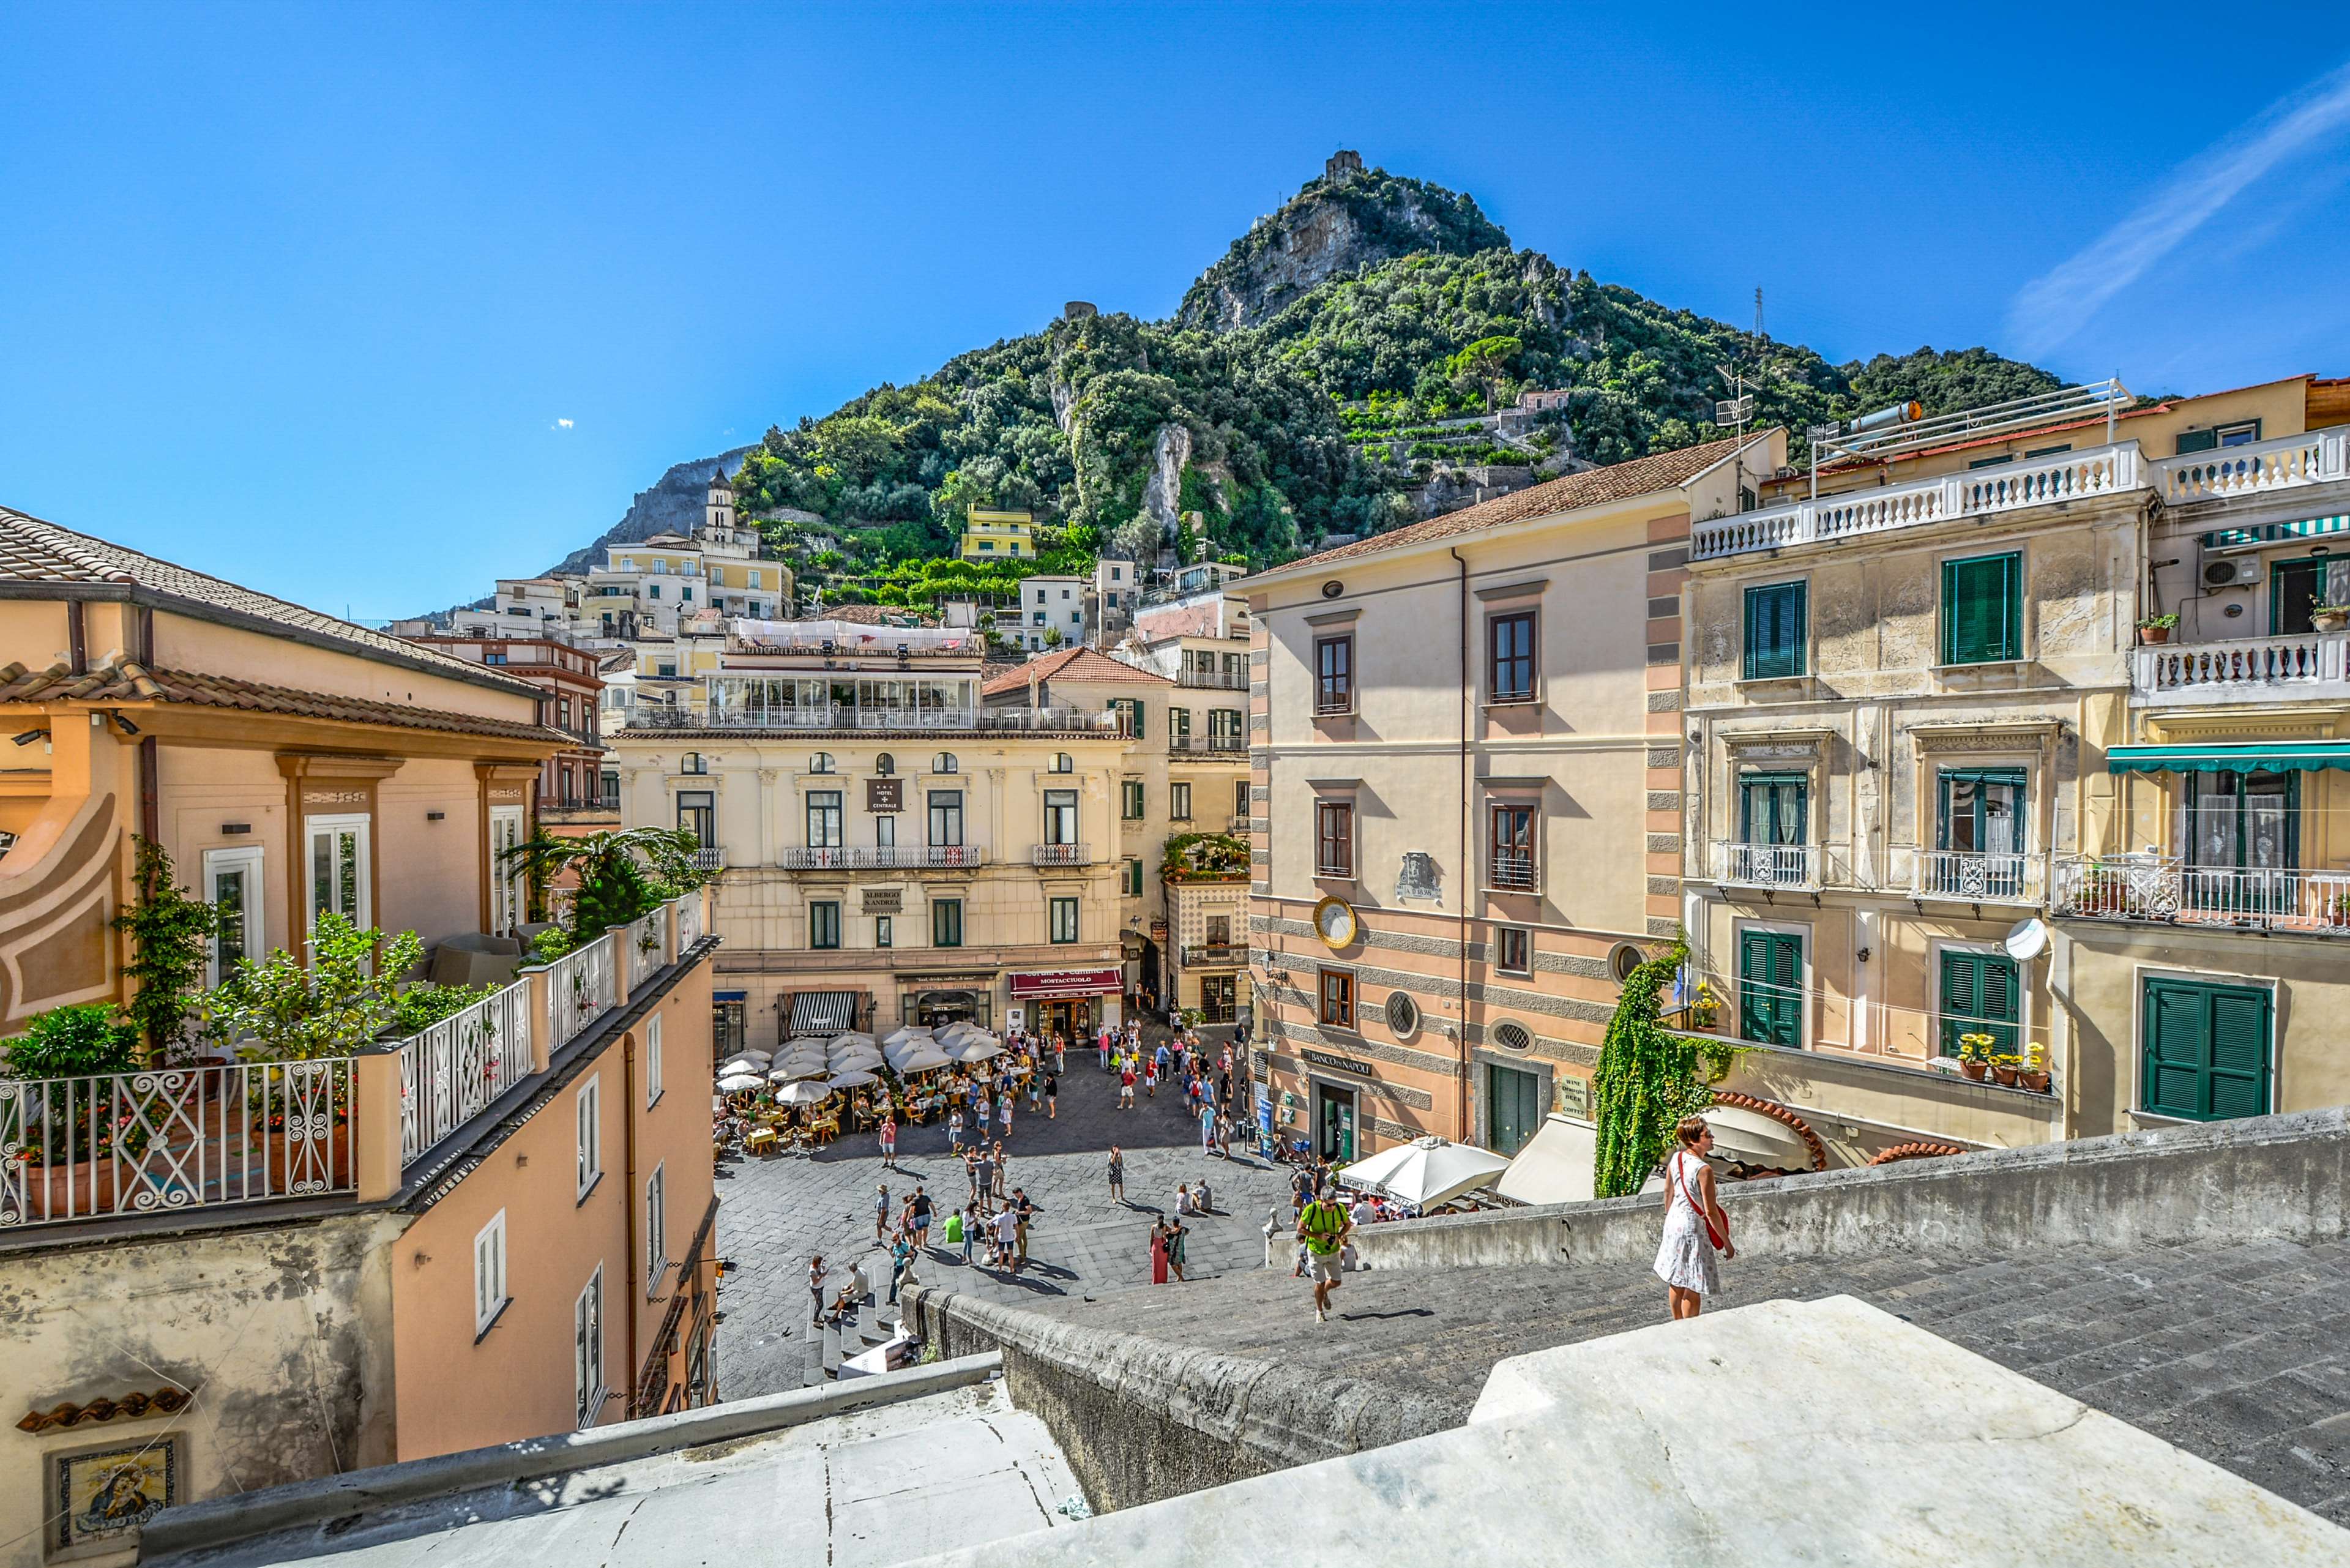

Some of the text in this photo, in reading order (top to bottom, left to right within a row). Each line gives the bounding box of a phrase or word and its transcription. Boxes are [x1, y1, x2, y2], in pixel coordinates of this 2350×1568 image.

[1311, 1053, 1336, 1066] BANCO
[1343, 1061, 1369, 1074] NAPOLI
[1562, 1086, 1585, 1095] Draught
[1562, 1107, 1584, 1116] COFFEE
[1343, 1177, 1364, 1189] LIGHT
